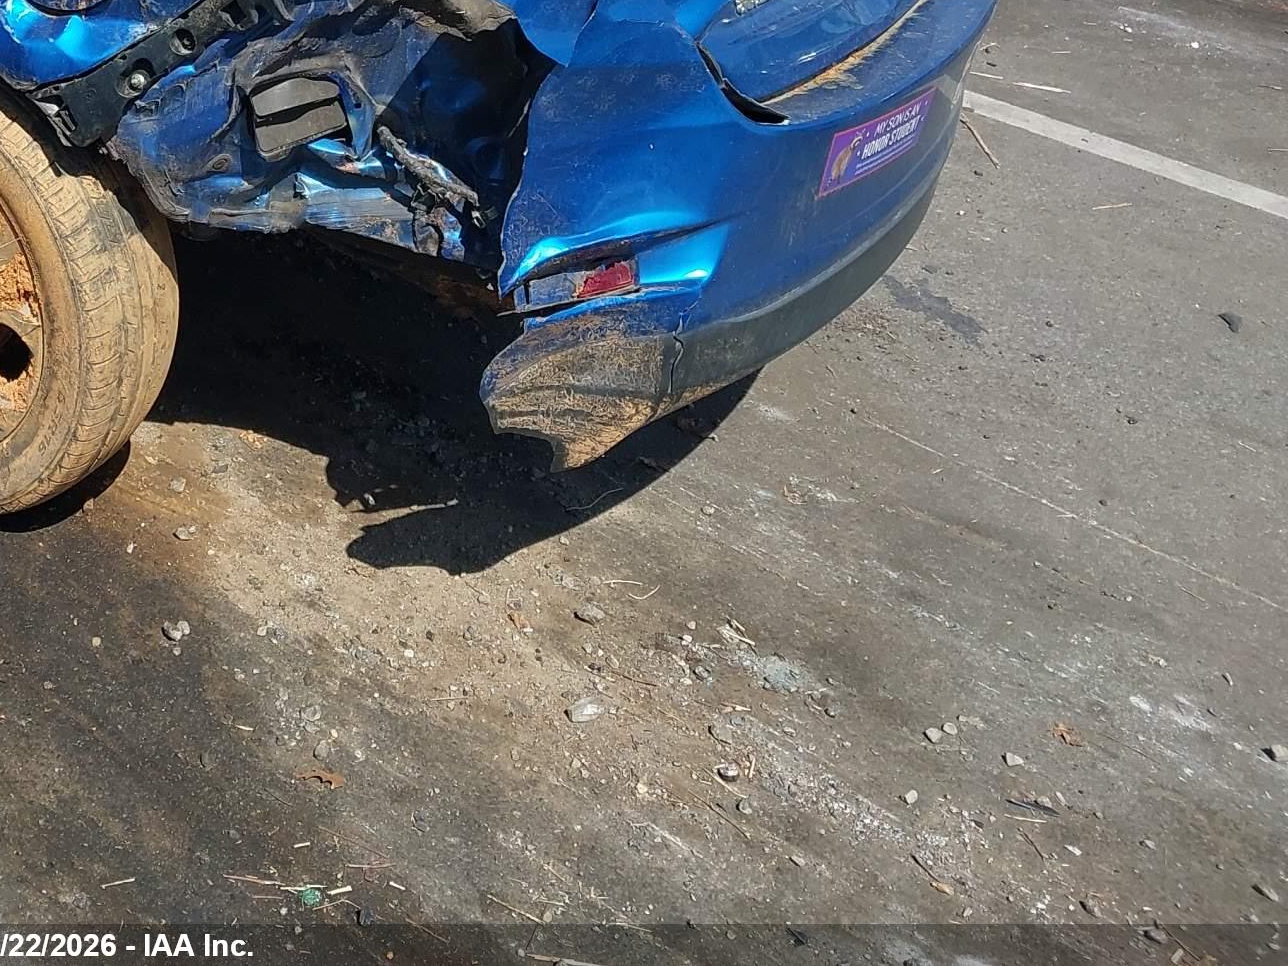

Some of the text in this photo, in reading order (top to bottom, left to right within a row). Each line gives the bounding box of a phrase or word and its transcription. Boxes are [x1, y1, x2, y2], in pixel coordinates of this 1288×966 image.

[861, 133, 891, 160] HONOR
[889, 114, 922, 146] STUDENT
[874, 121, 889, 137] MY
[887, 111, 906, 132] SON
